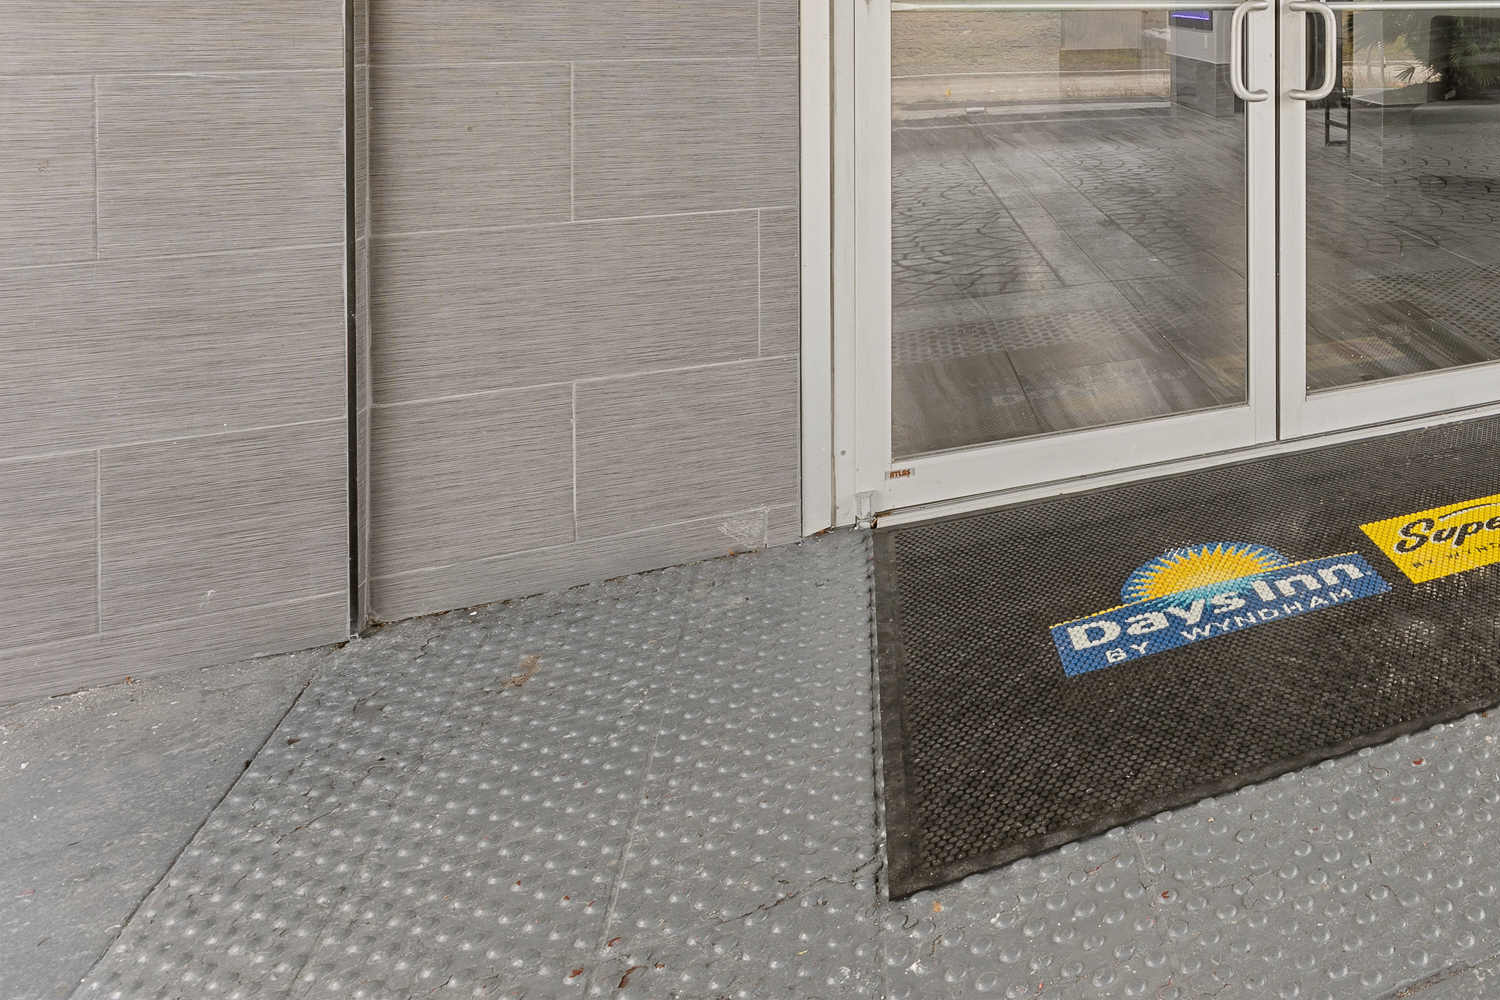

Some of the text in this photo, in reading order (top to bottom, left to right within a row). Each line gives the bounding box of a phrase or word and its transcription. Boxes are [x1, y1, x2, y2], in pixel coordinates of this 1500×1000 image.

[1067, 563, 1365, 650] Days Inn
[1105, 588, 1354, 664] BY WYNDHAM
